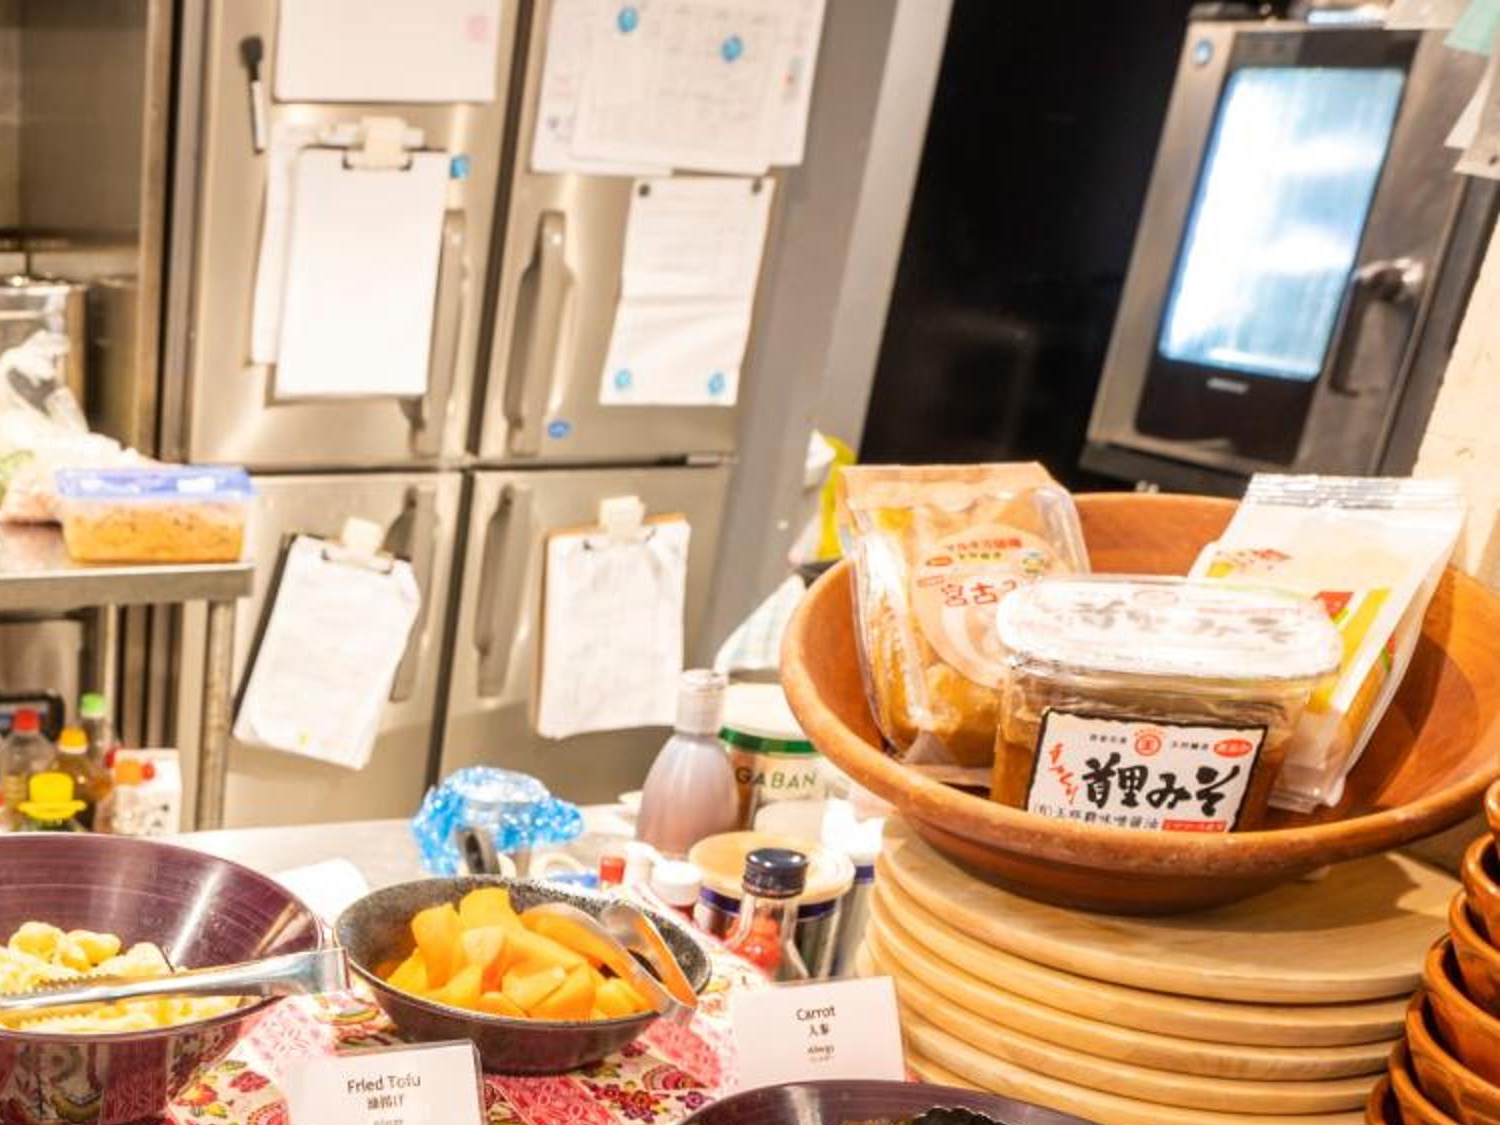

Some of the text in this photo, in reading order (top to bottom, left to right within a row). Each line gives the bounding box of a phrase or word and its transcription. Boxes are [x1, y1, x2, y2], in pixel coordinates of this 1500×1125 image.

[735, 767, 818, 790] GABAN
[1082, 752, 1241, 817] 首里みそ
[796, 1006, 836, 1022] Carrot
[347, 1073, 421, 1094] Fried Tofu
